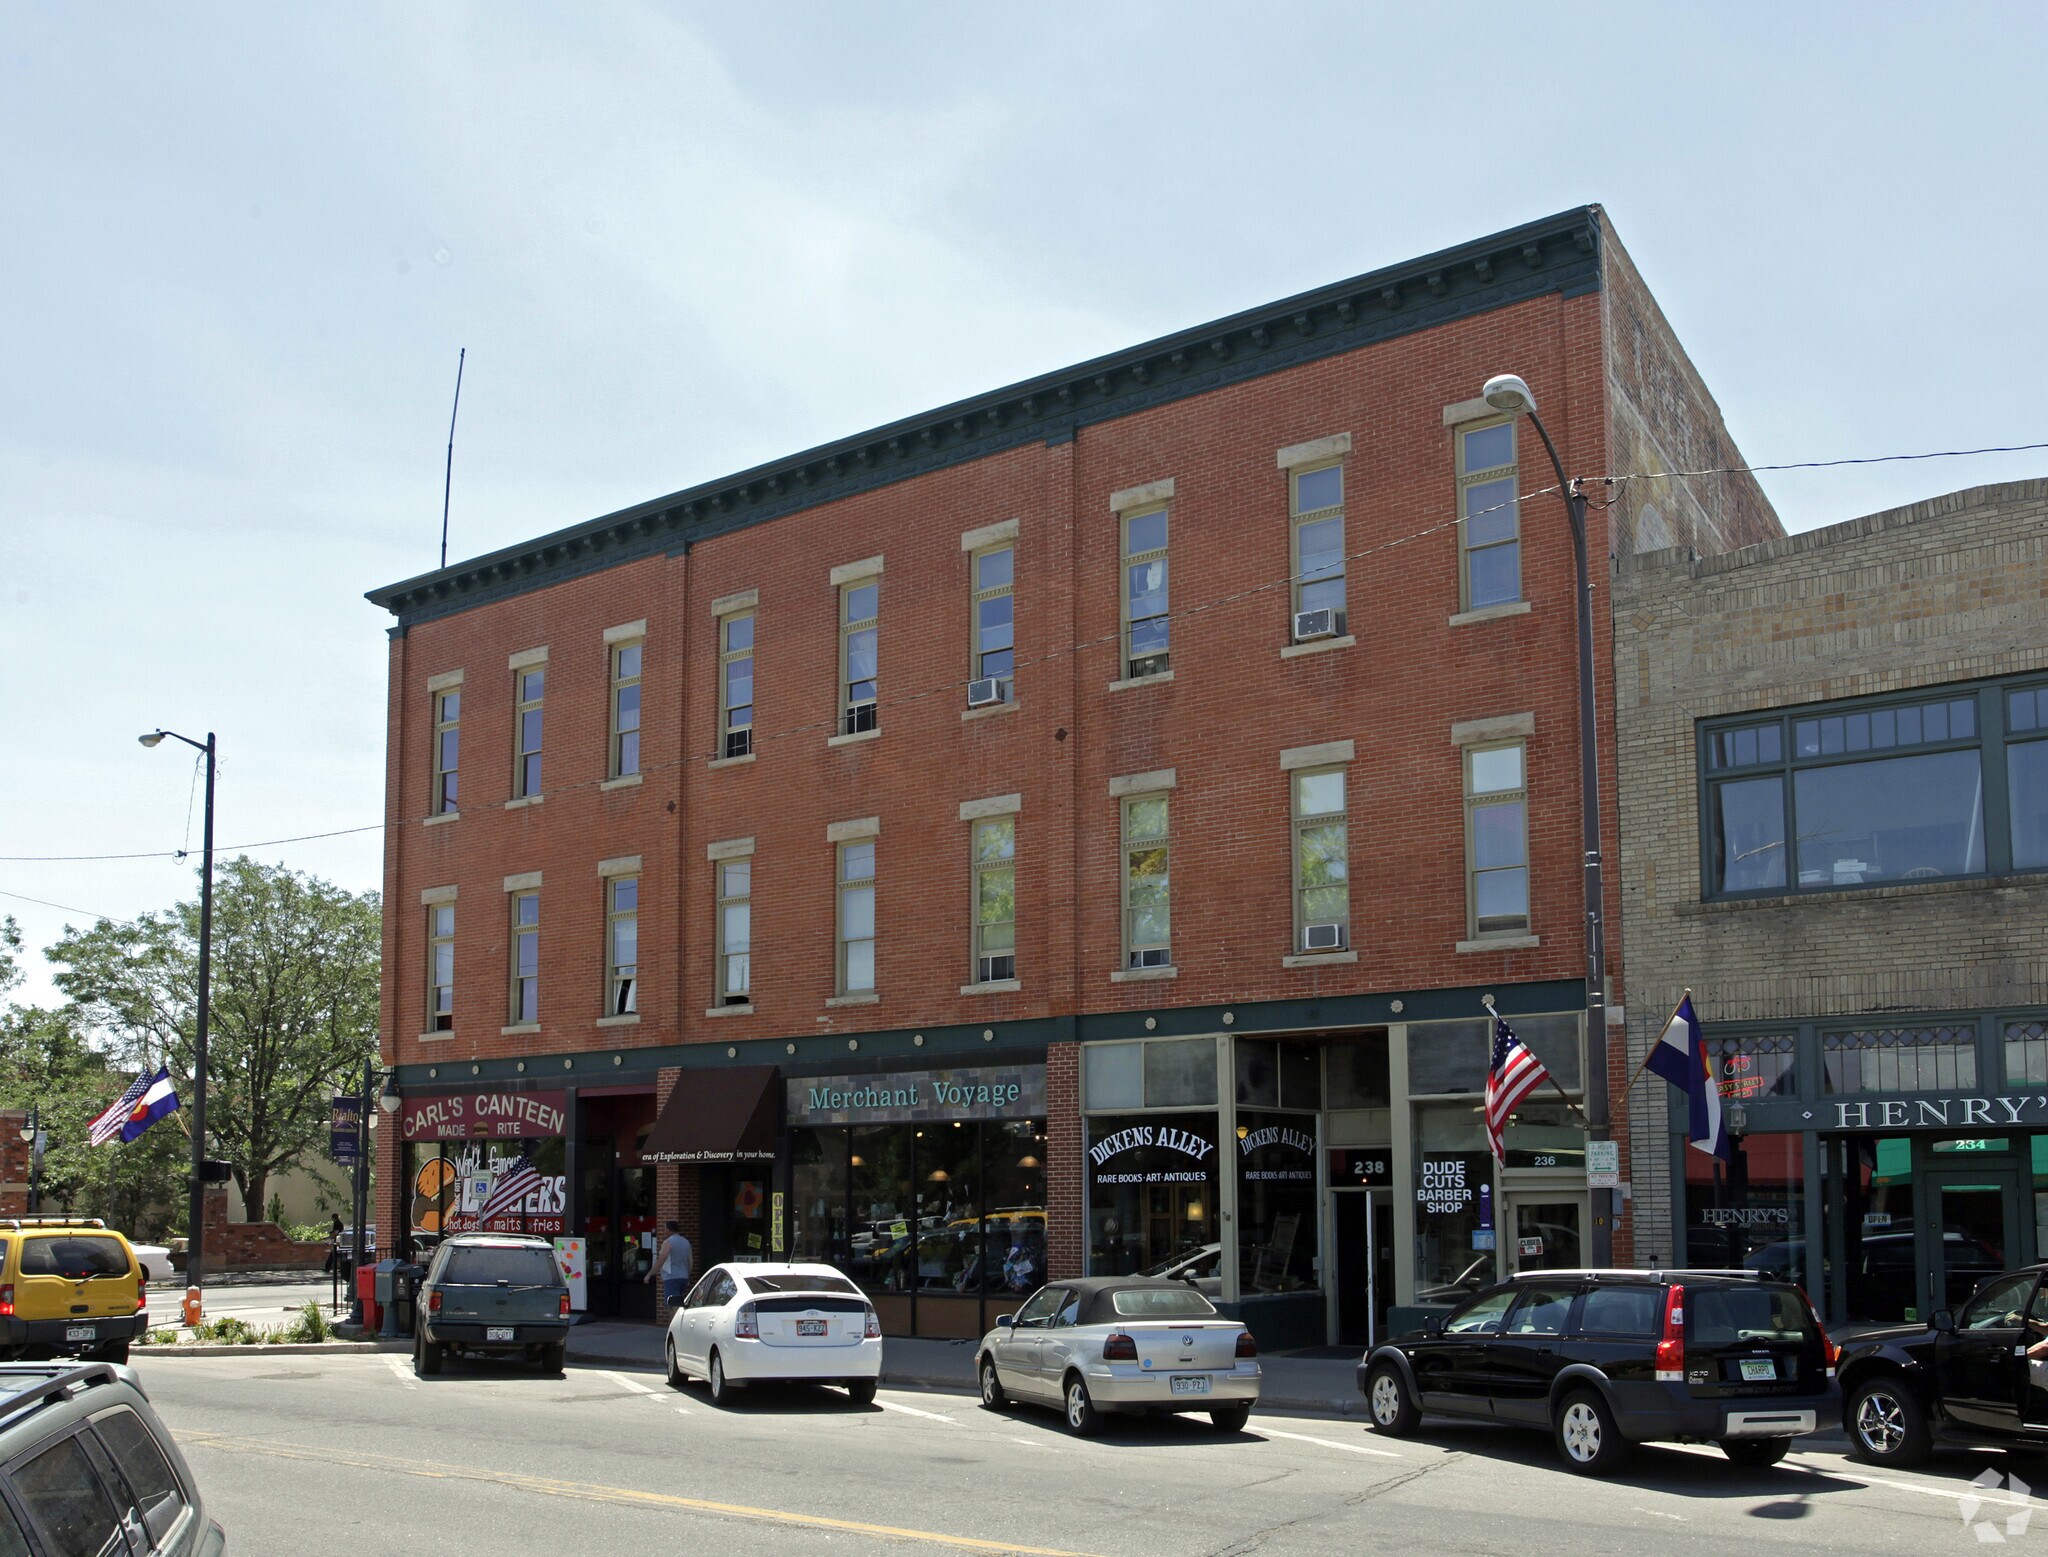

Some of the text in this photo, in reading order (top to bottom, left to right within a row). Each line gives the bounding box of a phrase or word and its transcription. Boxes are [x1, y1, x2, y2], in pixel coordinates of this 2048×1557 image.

[809, 1081, 1020, 1110] Merchant Voyage
[332, 1108, 359, 1122] Rialto
[403, 1094, 564, 1137] CARL'S CANTEEN
[437, 1122, 521, 1137] MADE RITE
[1089, 1126, 1214, 1166] DICKENS ALLEY
[1240, 1127, 1317, 1156] DICKENS ALLEY
[1956, 1139, 1986, 1150] 234
[652, 1152, 660, 1162] of
[660, 1151, 696, 1162] Exploration
[696, 1150, 703, 1159] &
[703, 1150, 734, 1161] Discovery
[736, 1150, 743, 1158] in
[744, 1152, 758, 1160] your
[1534, 1156, 1556, 1166] 236
[1354, 1161, 1385, 1174] 238
[1423, 1161, 1466, 1175] DUDE
[1097, 1174, 1117, 1183] RARE
[1164, 1171, 1207, 1182] ANTIQUES
[1245, 1171, 1260, 1179] RARE
[1288, 1171, 1312, 1179] ANTIQUES
[1423, 1175, 1466, 1188] CUTS
[1417, 1189, 1472, 1201] BARBER
[1426, 1202, 1463, 1213] SHOP
[773, 1194, 783, 1250] OPEN
[1594, 1218, 1604, 1226] 10
[1702, 1208, 1789, 1224] HENRY'S
[1868, 1215, 1888, 1224] OPEN
[449, 1217, 560, 1232] hot dogs malts fries
[1520, 1239, 1541, 1247] CLOSED
